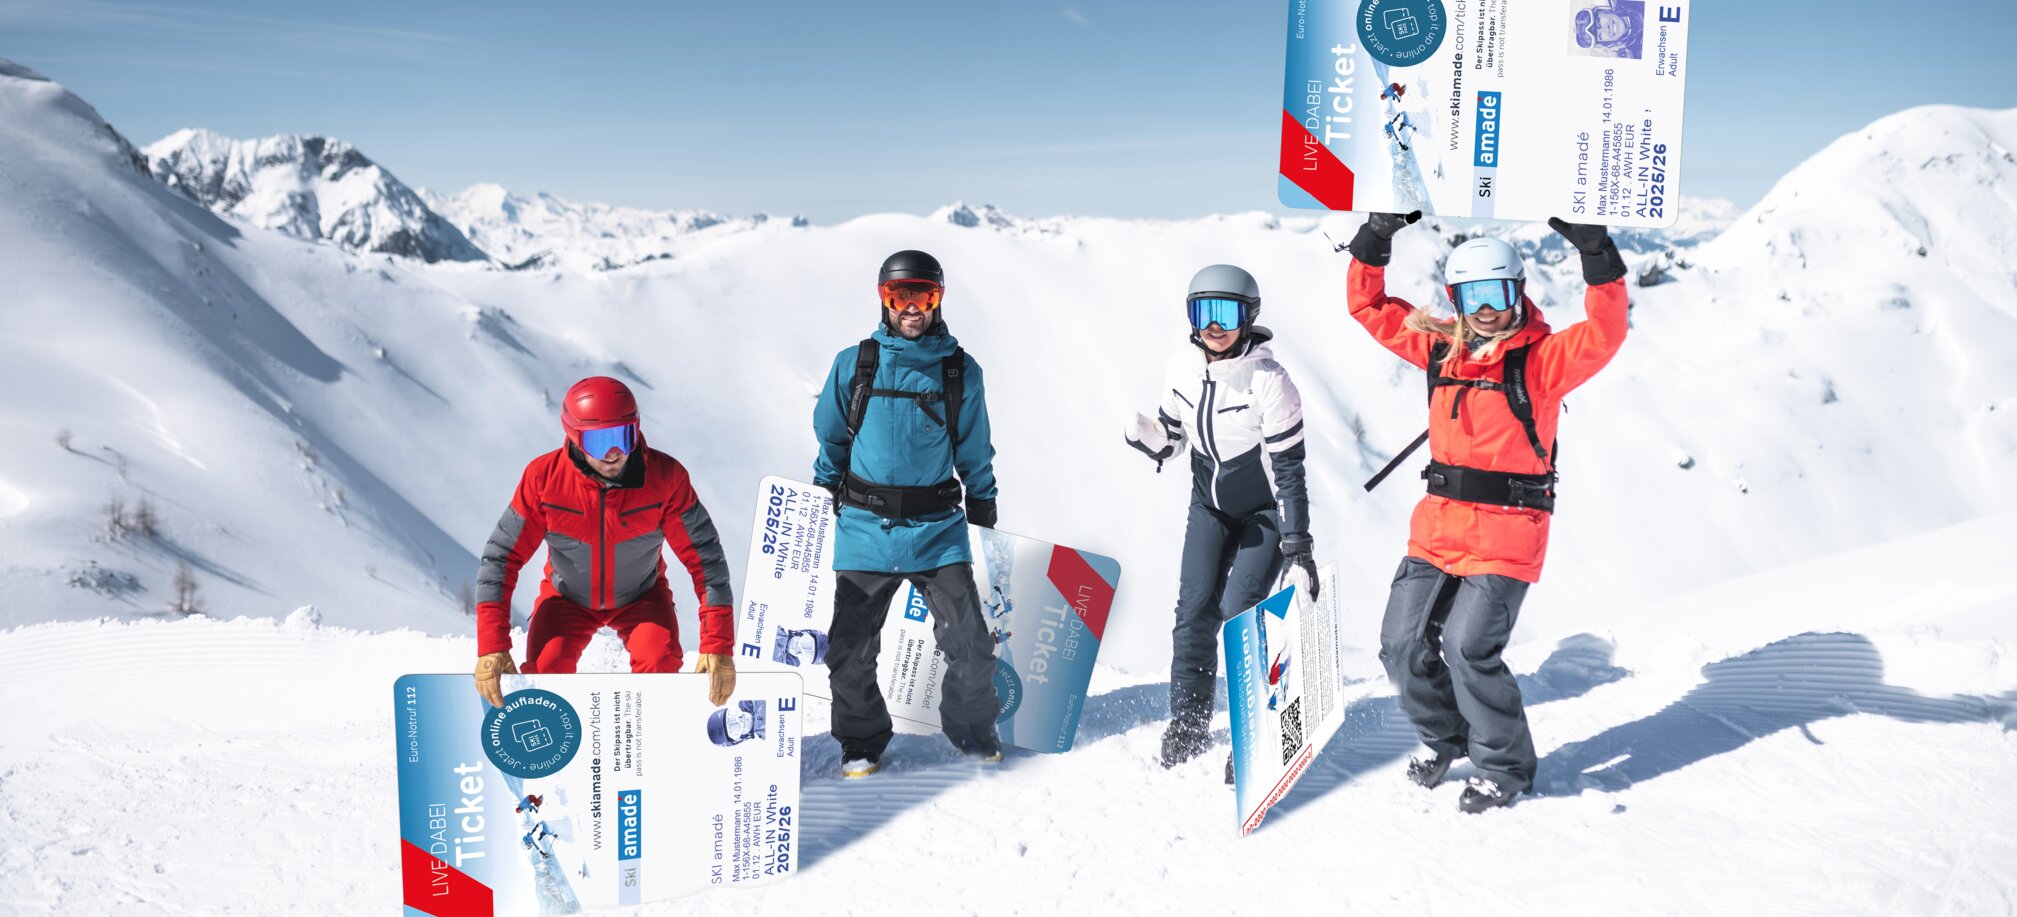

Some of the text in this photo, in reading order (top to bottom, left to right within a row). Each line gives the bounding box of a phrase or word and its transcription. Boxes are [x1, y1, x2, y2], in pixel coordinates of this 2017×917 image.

[1364, 0, 1389, 55] Jetzt online
[1395, 4, 1440, 60] top it up online
[1476, 20, 1486, 54] Skipass
[1478, 8, 1486, 20] ist
[1658, 6, 1681, 23] E
[1475, 55, 1483, 70] Der
[1486, 15, 1497, 68] übertragbar.
[1656, 25, 1667, 76] Erwachsen
[1668, 53, 1679, 77] Adult
[1497, 61, 1505, 78] pass
[1325, 43, 1356, 145] Ticket
[1303, 79, 1322, 171] LIVE DABEI
[1477, 95, 1497, 198] Ski amadé
[1597, 68, 1614, 216] Max Mustermann 14.01.1986
[1625, 124, 1636, 149] EUR
[1639, 118, 1653, 161] White
[1573, 131, 1590, 214] SKI amadé
[1609, 122, 1623, 216] 1-156X-68-A45855
[1623, 152, 1634, 179] AWH
[1649, 143, 1667, 219] 2025/26
[1620, 187, 1632, 217] 01.12
[1636, 166, 1650, 218] ALL-IN
[762, 483, 785, 555] 2025/26
[798, 491, 811, 518] 01.12
[774, 487, 798, 579] ALL-IN White
[794, 523, 805, 548] AWH
[800, 495, 822, 573] 1-156X-68-A45855
[790, 549, 802, 570] EUR
[803, 496, 833, 619] Max Mustermann 14.01.1986
[747, 600, 757, 621] Adult
[755, 603, 769, 643] Erwachsen
[1061, 585, 1093, 661] LIVE DABEI
[741, 642, 761, 659] E
[911, 652, 922, 679] Skipass
[917, 639, 925, 652] Der
[1025, 604, 1069, 685] Ticket
[624, 702, 632, 717] The
[778, 697, 796, 712] E
[905, 688, 913, 705] nicht
[1000, 688, 1016, 714] online
[406, 686, 419, 763] Euro-Notruf 112
[489, 696, 558, 769] Jetzt online aufladen
[560, 712, 572, 730] top
[613, 690, 623, 772] Der Skipass ist nicht
[624, 718, 634, 769] übertragbar.
[776, 714, 785, 758] Erwachsen
[1056, 735, 1066, 749] 112
[529, 753, 562, 771] online
[559, 741, 571, 754] up
[786, 736, 795, 758] Adult
[589, 691, 602, 851] www.skiamade.com/ticket
[453, 761, 486, 868] Ticket
[732, 756, 743, 883] Max Mustermann 14.01.1986
[752, 824, 761, 847] AWH
[753, 801, 762, 823] EUR
[764, 784, 778, 876] ALL-IN White
[428, 803, 449, 896] LIVE DABEI
[618, 794, 638, 888] Ski amadé
[711, 813, 724, 885] SKI amadé
[742, 801, 752, 880] 1-156X-68-A45855
[776, 805, 792, 873] 2025/26
[752, 854, 761, 880] 01.12
